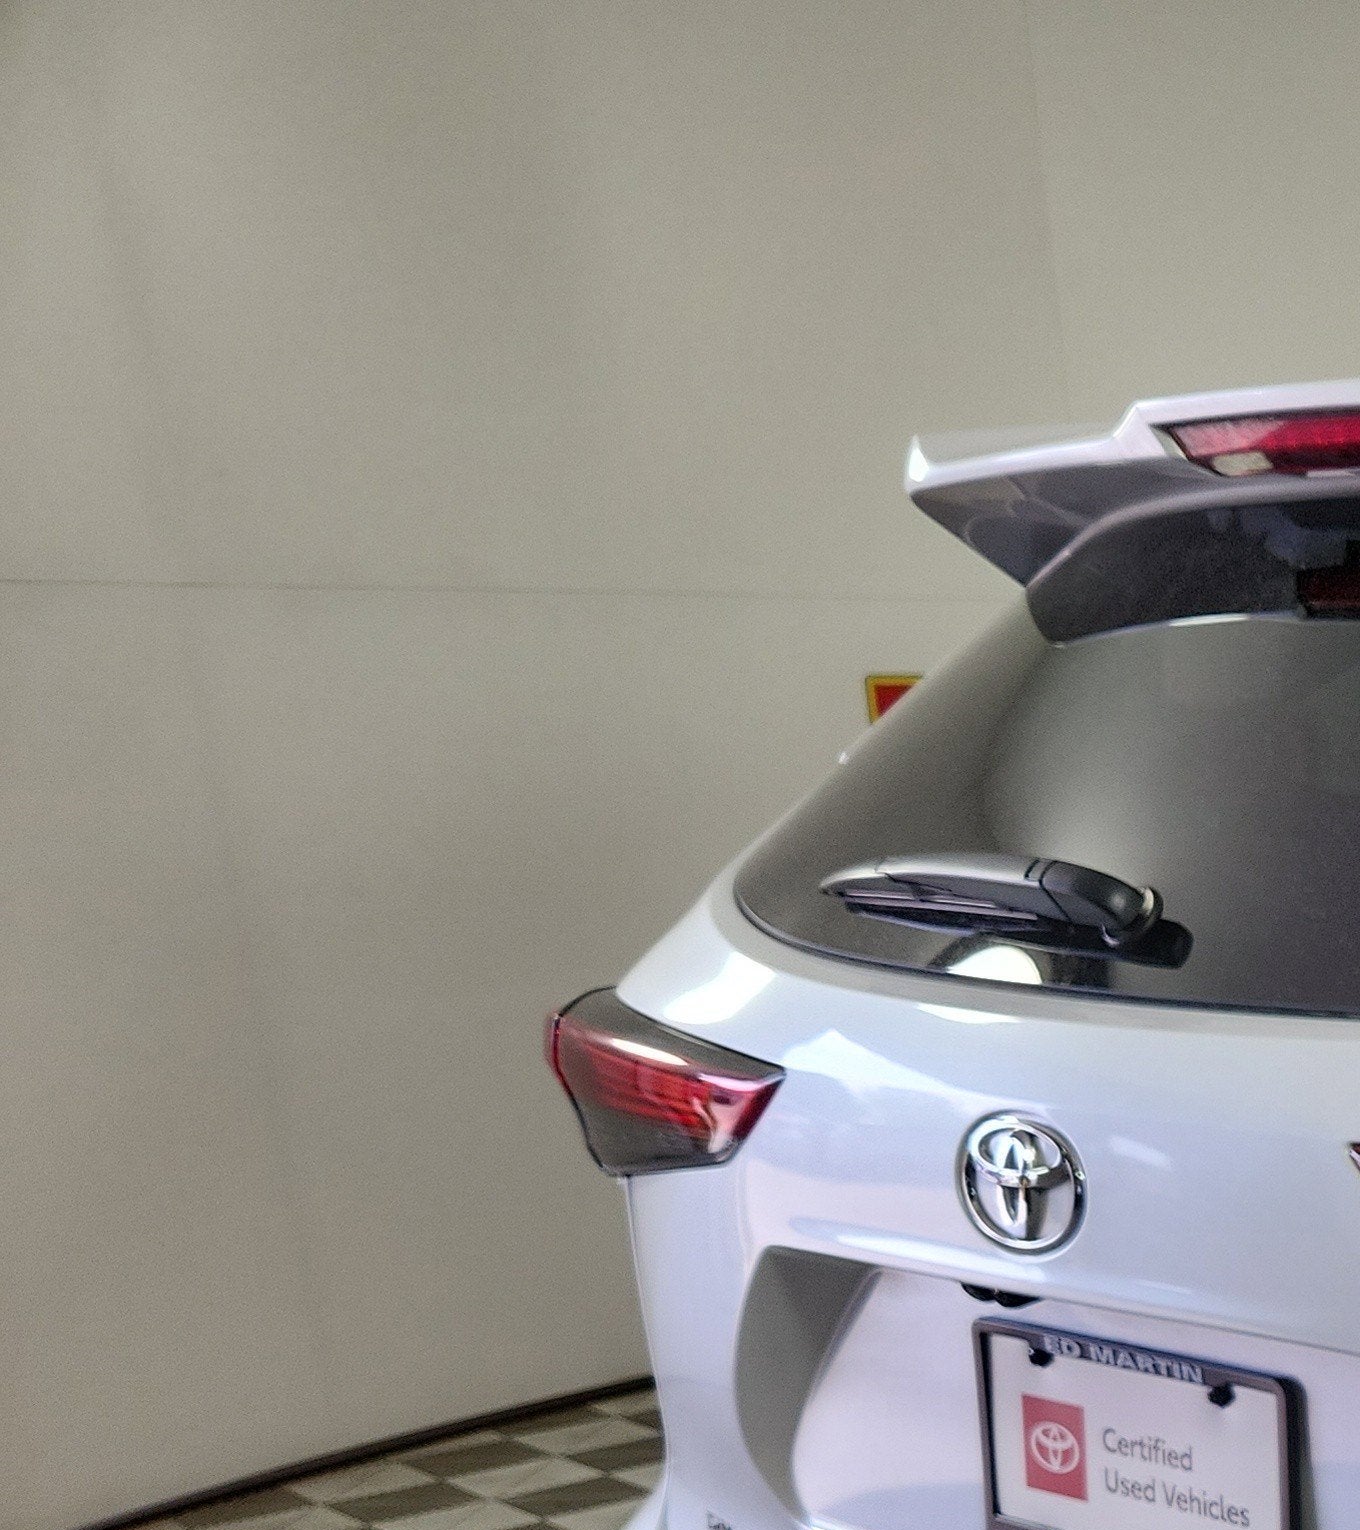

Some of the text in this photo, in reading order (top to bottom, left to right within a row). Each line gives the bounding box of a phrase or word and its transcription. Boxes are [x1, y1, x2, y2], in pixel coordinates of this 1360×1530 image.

[1043, 1334, 1206, 1385] ED MARTIN
[1102, 1427, 1193, 1472] Certified
[1104, 1466, 1251, 1528] Used Vehicles
